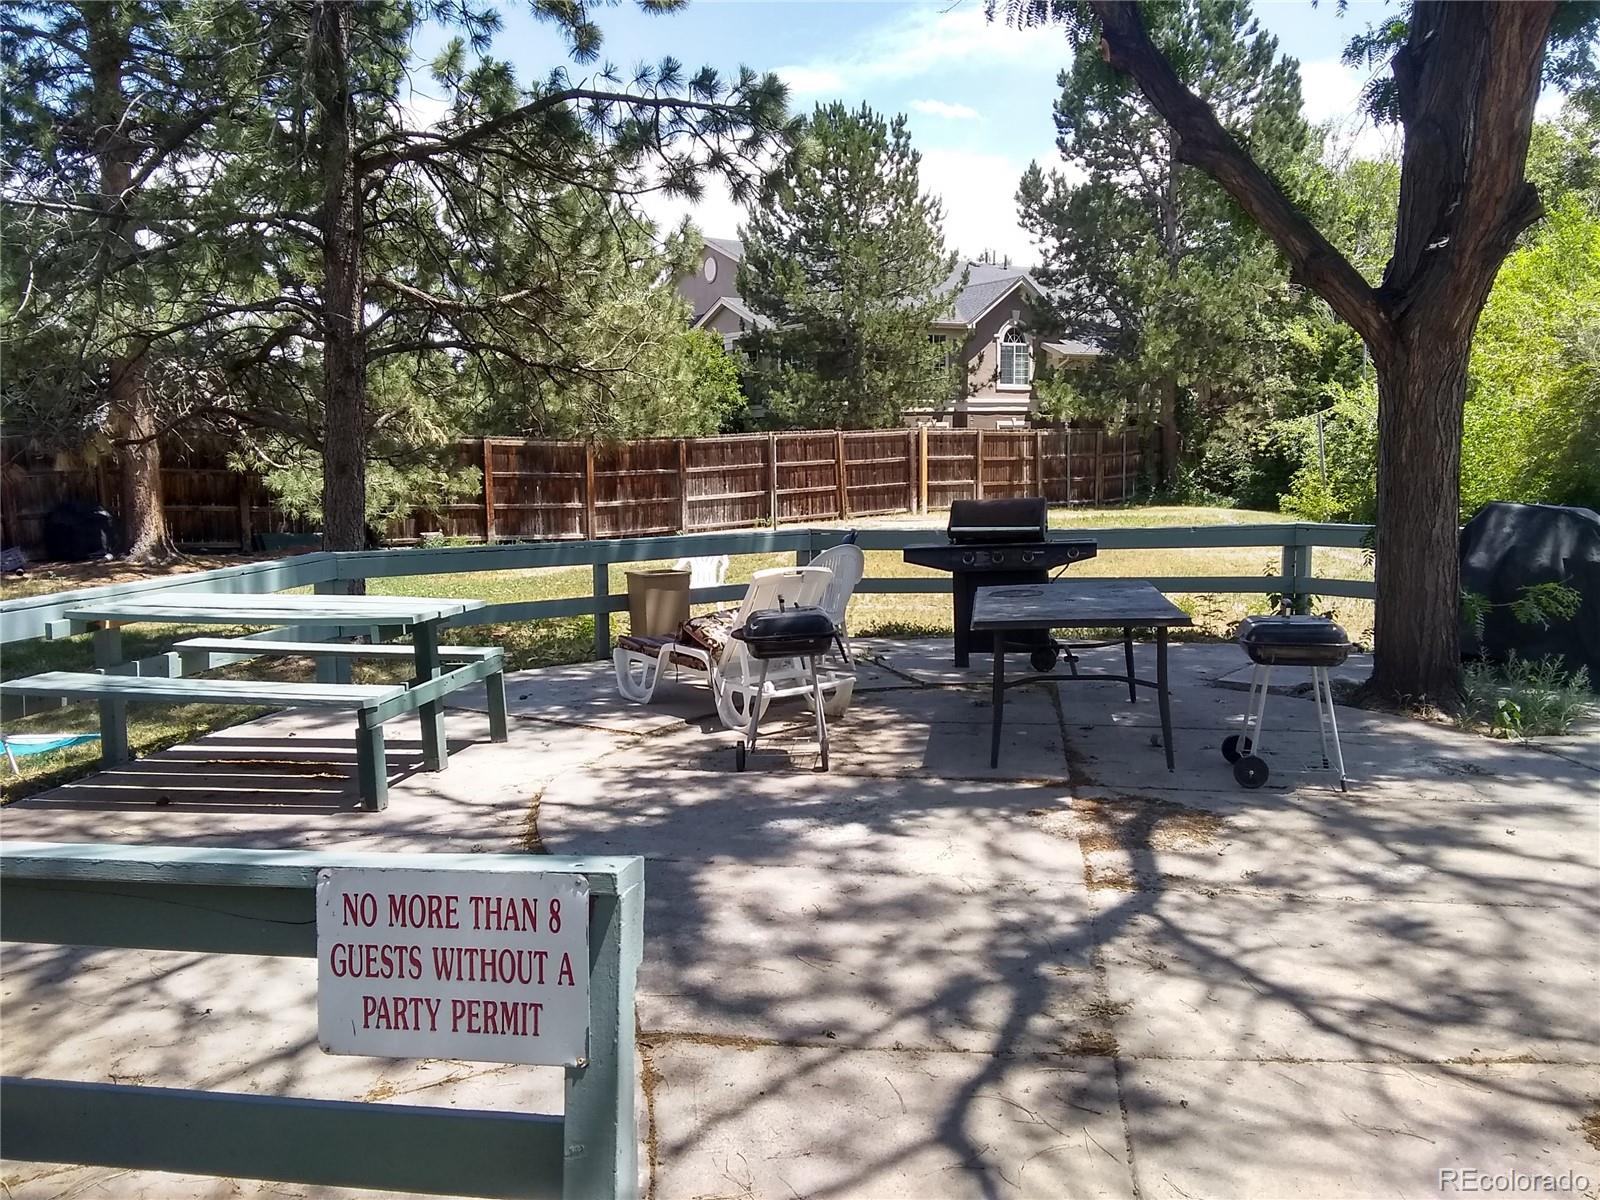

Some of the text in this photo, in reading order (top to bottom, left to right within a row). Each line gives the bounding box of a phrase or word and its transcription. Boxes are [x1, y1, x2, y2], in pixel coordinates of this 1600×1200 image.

[342, 893, 561, 933] NO MORE THAN 8
[330, 943, 575, 986] GUESTS WITHOUT A
[362, 996, 543, 1036] PARTY PERMIT
